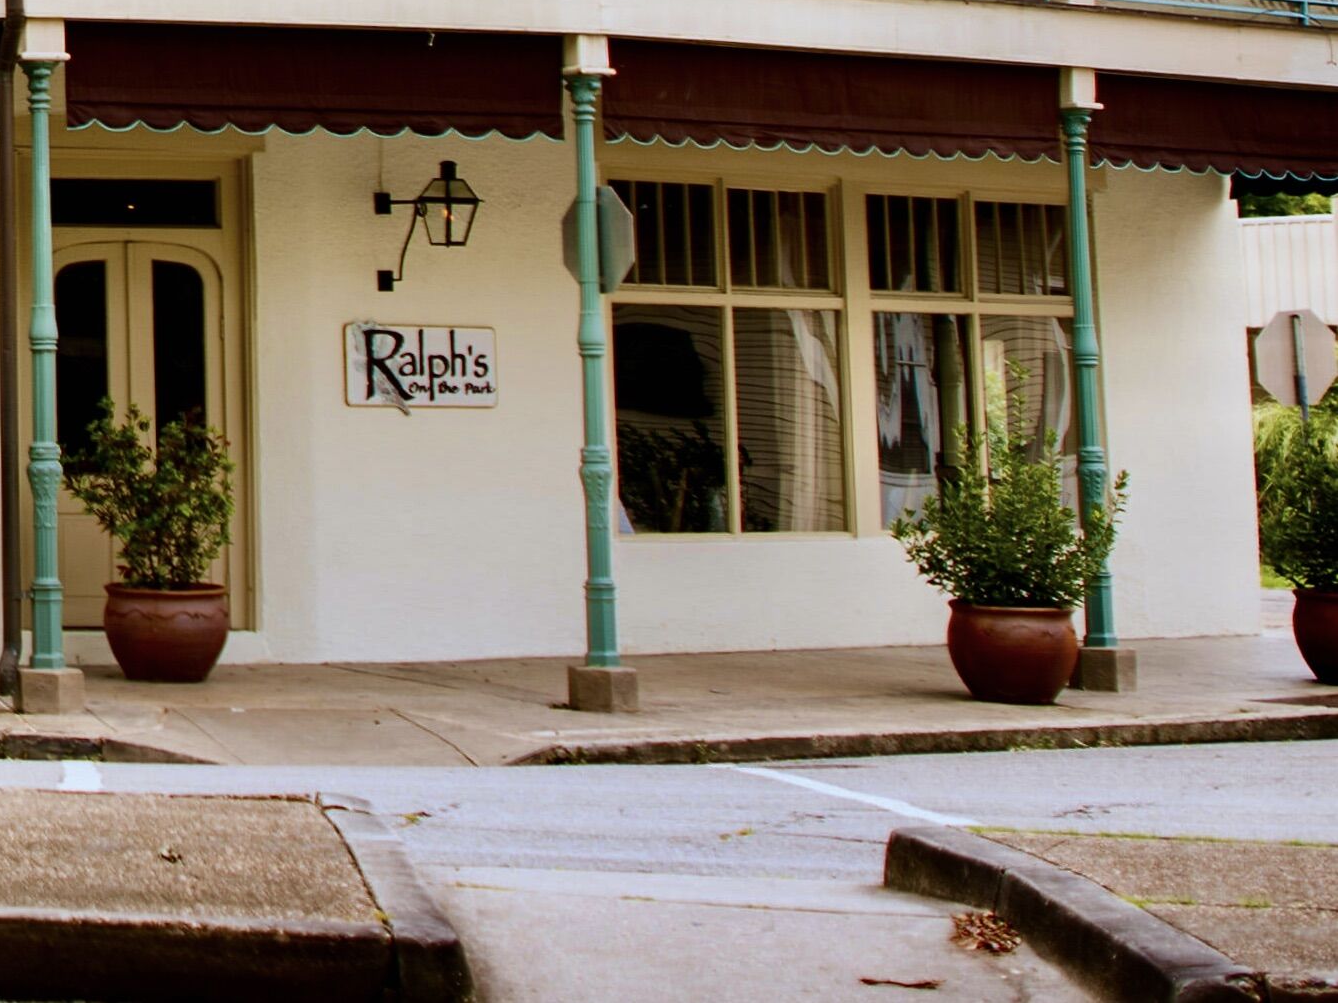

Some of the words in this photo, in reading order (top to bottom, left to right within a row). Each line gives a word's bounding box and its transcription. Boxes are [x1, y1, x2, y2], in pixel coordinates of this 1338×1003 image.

[363, 329, 488, 401] Ralph's
[409, 382, 430, 394] On
[438, 381, 460, 394] the
[465, 381, 495, 395] Park
